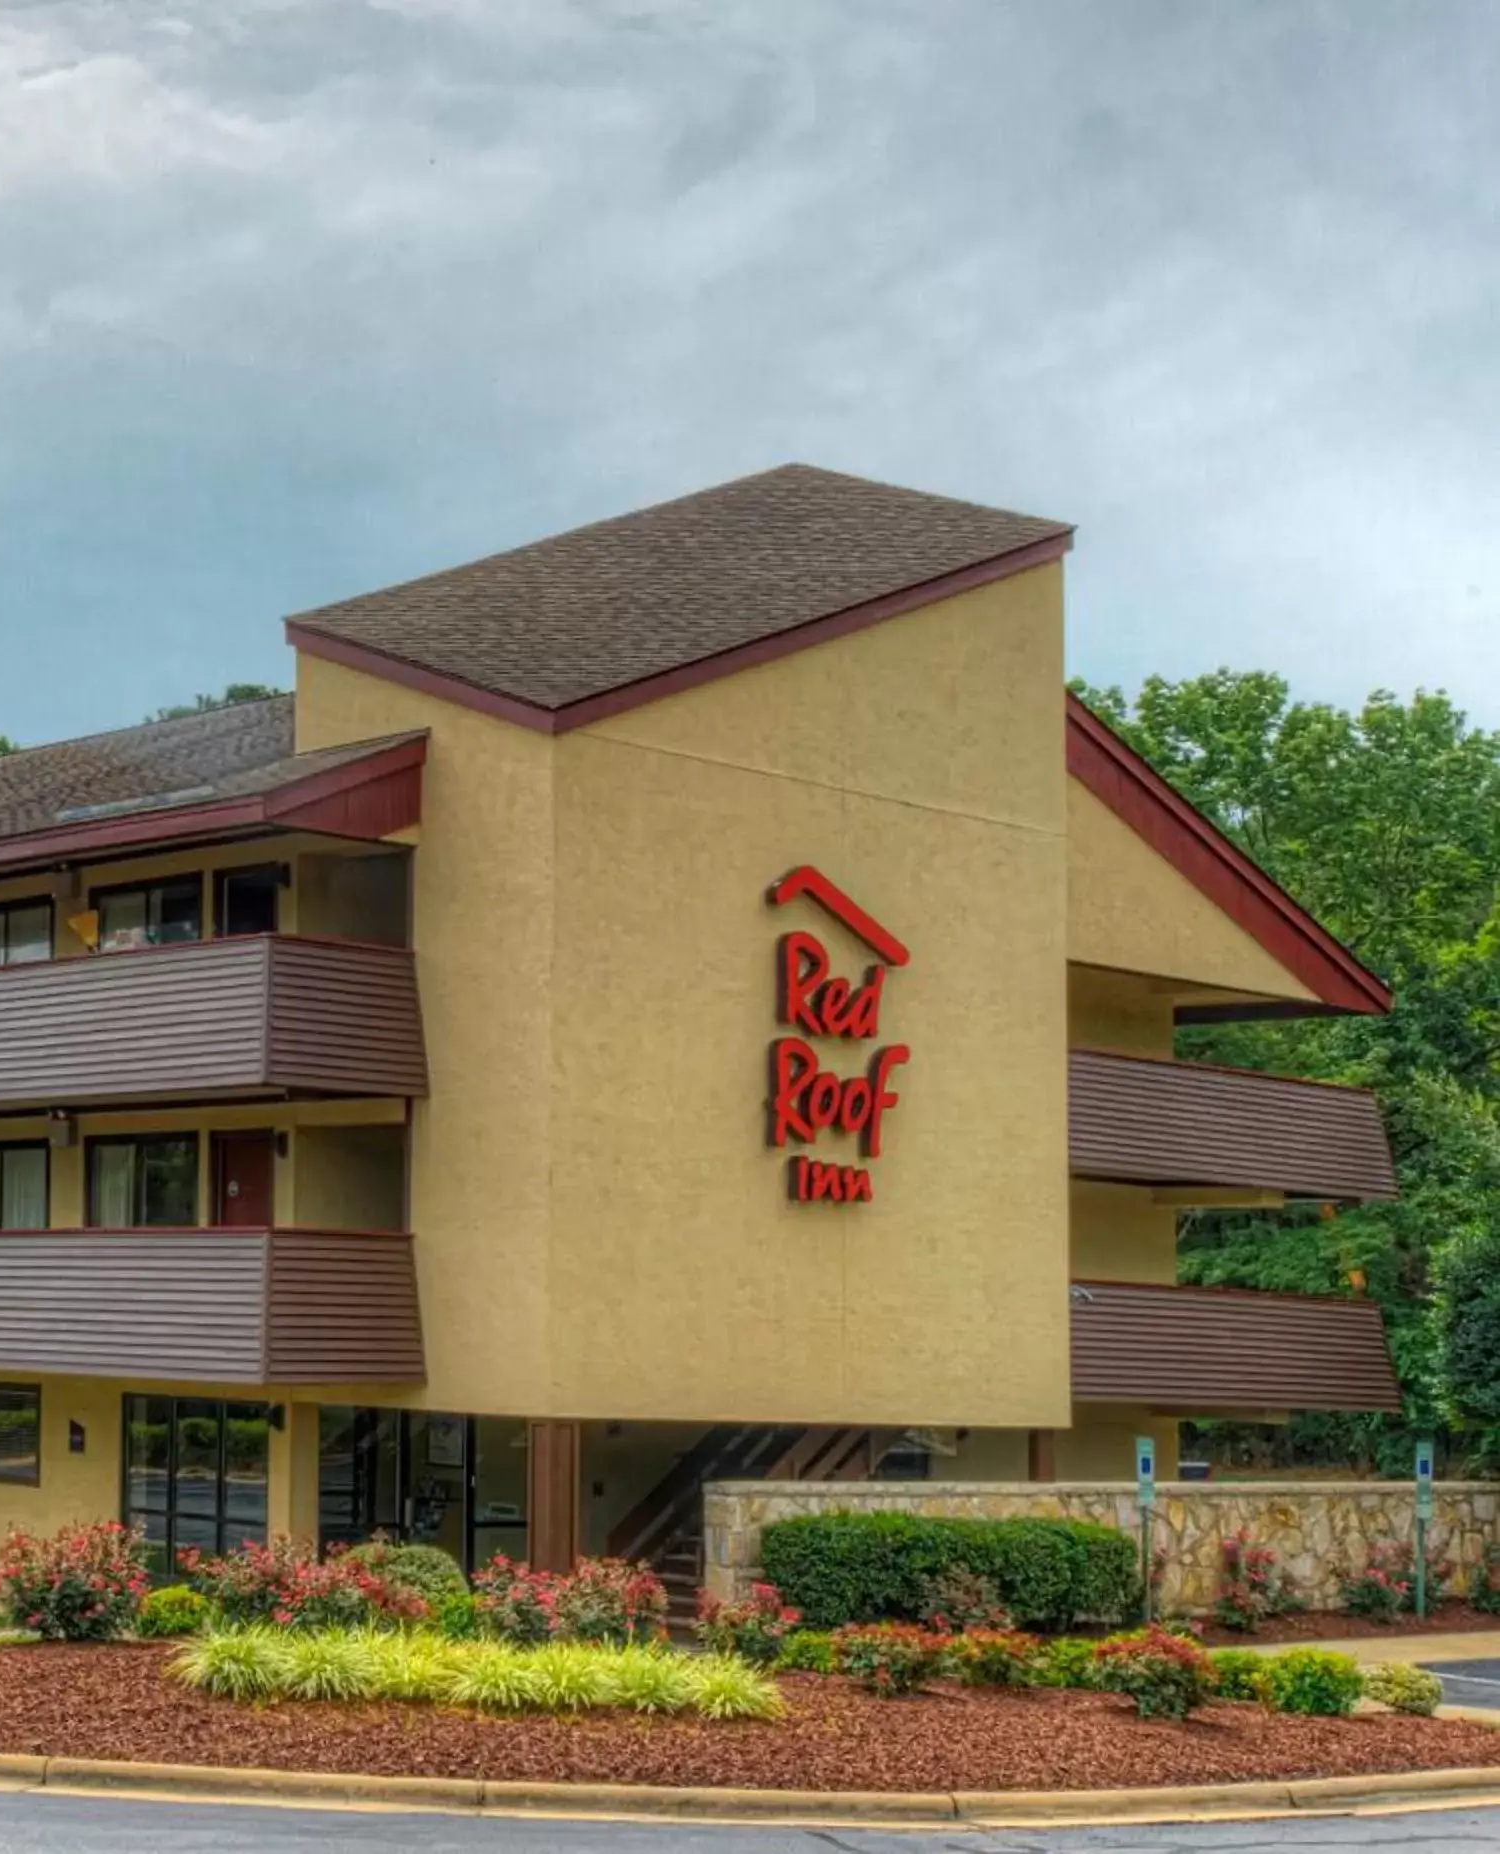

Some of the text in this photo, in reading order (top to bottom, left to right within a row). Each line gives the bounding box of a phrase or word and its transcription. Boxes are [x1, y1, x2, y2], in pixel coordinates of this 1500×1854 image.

[780, 930, 886, 1038] Red
[770, 1037, 910, 1158] Roof
[791, 1155, 872, 1203] Inn
